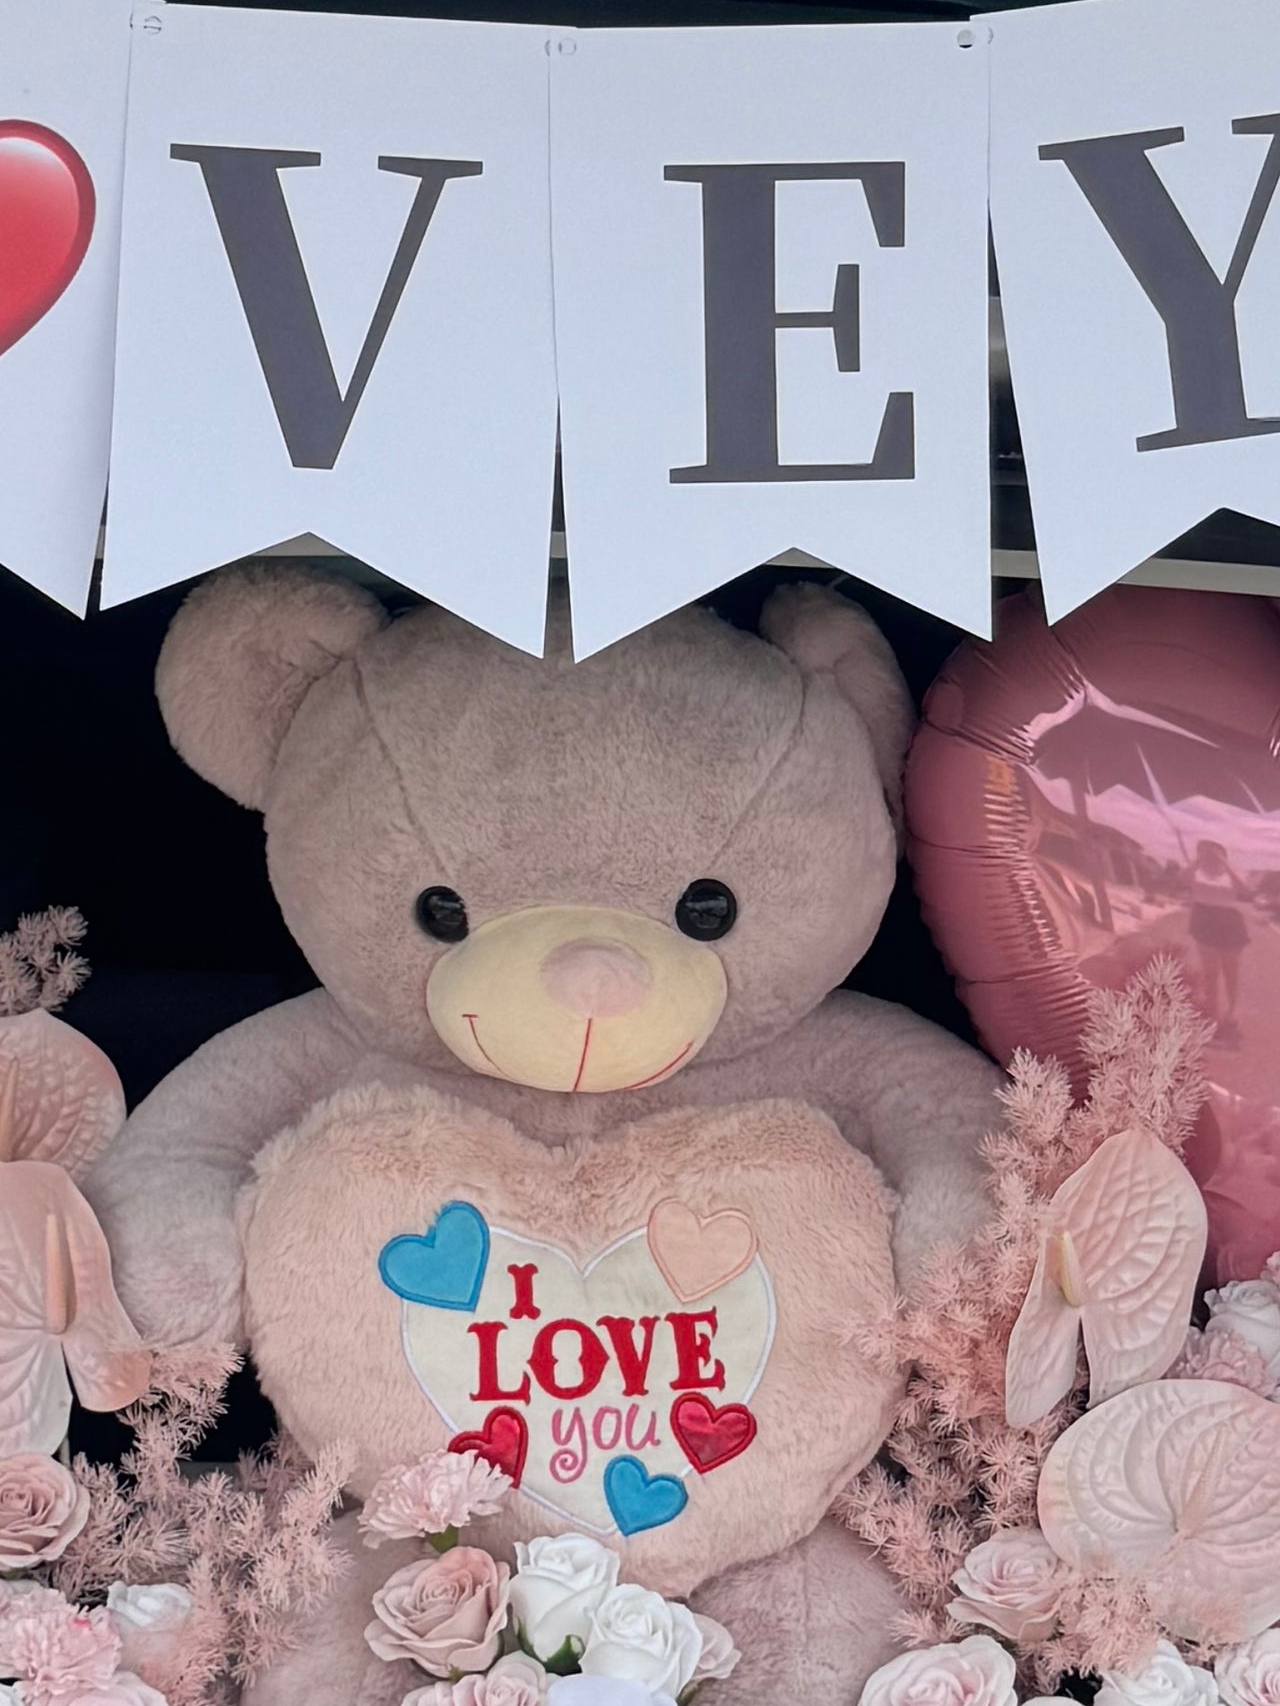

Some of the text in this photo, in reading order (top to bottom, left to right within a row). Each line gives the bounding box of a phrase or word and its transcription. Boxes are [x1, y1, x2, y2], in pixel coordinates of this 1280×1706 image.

[507, 1262, 541, 1321] I
[467, 1306, 726, 1405] LOVE
[549, 1402, 660, 1484] you
